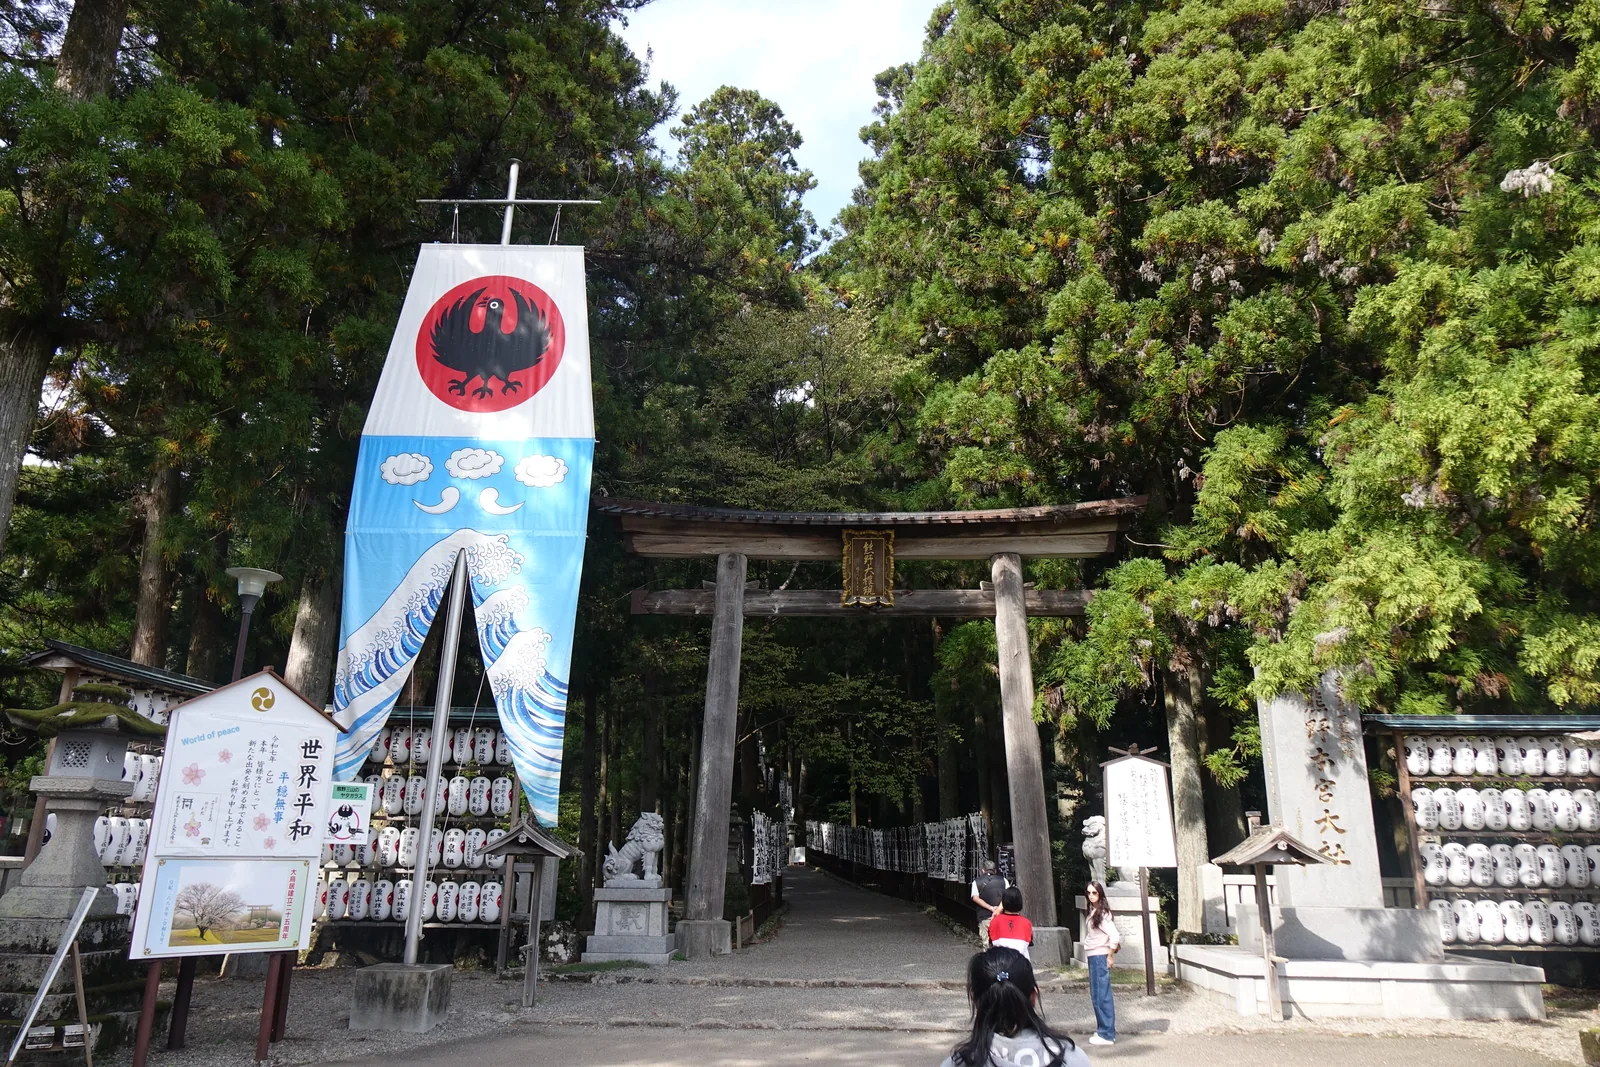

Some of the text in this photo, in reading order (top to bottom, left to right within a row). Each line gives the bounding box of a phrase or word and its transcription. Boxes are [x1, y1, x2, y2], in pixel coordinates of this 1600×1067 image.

[181, 725, 240, 746] World of peace
[269, 735, 280, 764] 令和七年
[250, 740, 268, 810] 本年 皆様方にとって
[273, 771, 290, 824] 平穏無事
[288, 738, 323, 841] 世界平和
[281, 868, 297, 940] 大鳥居建立二十五周年
